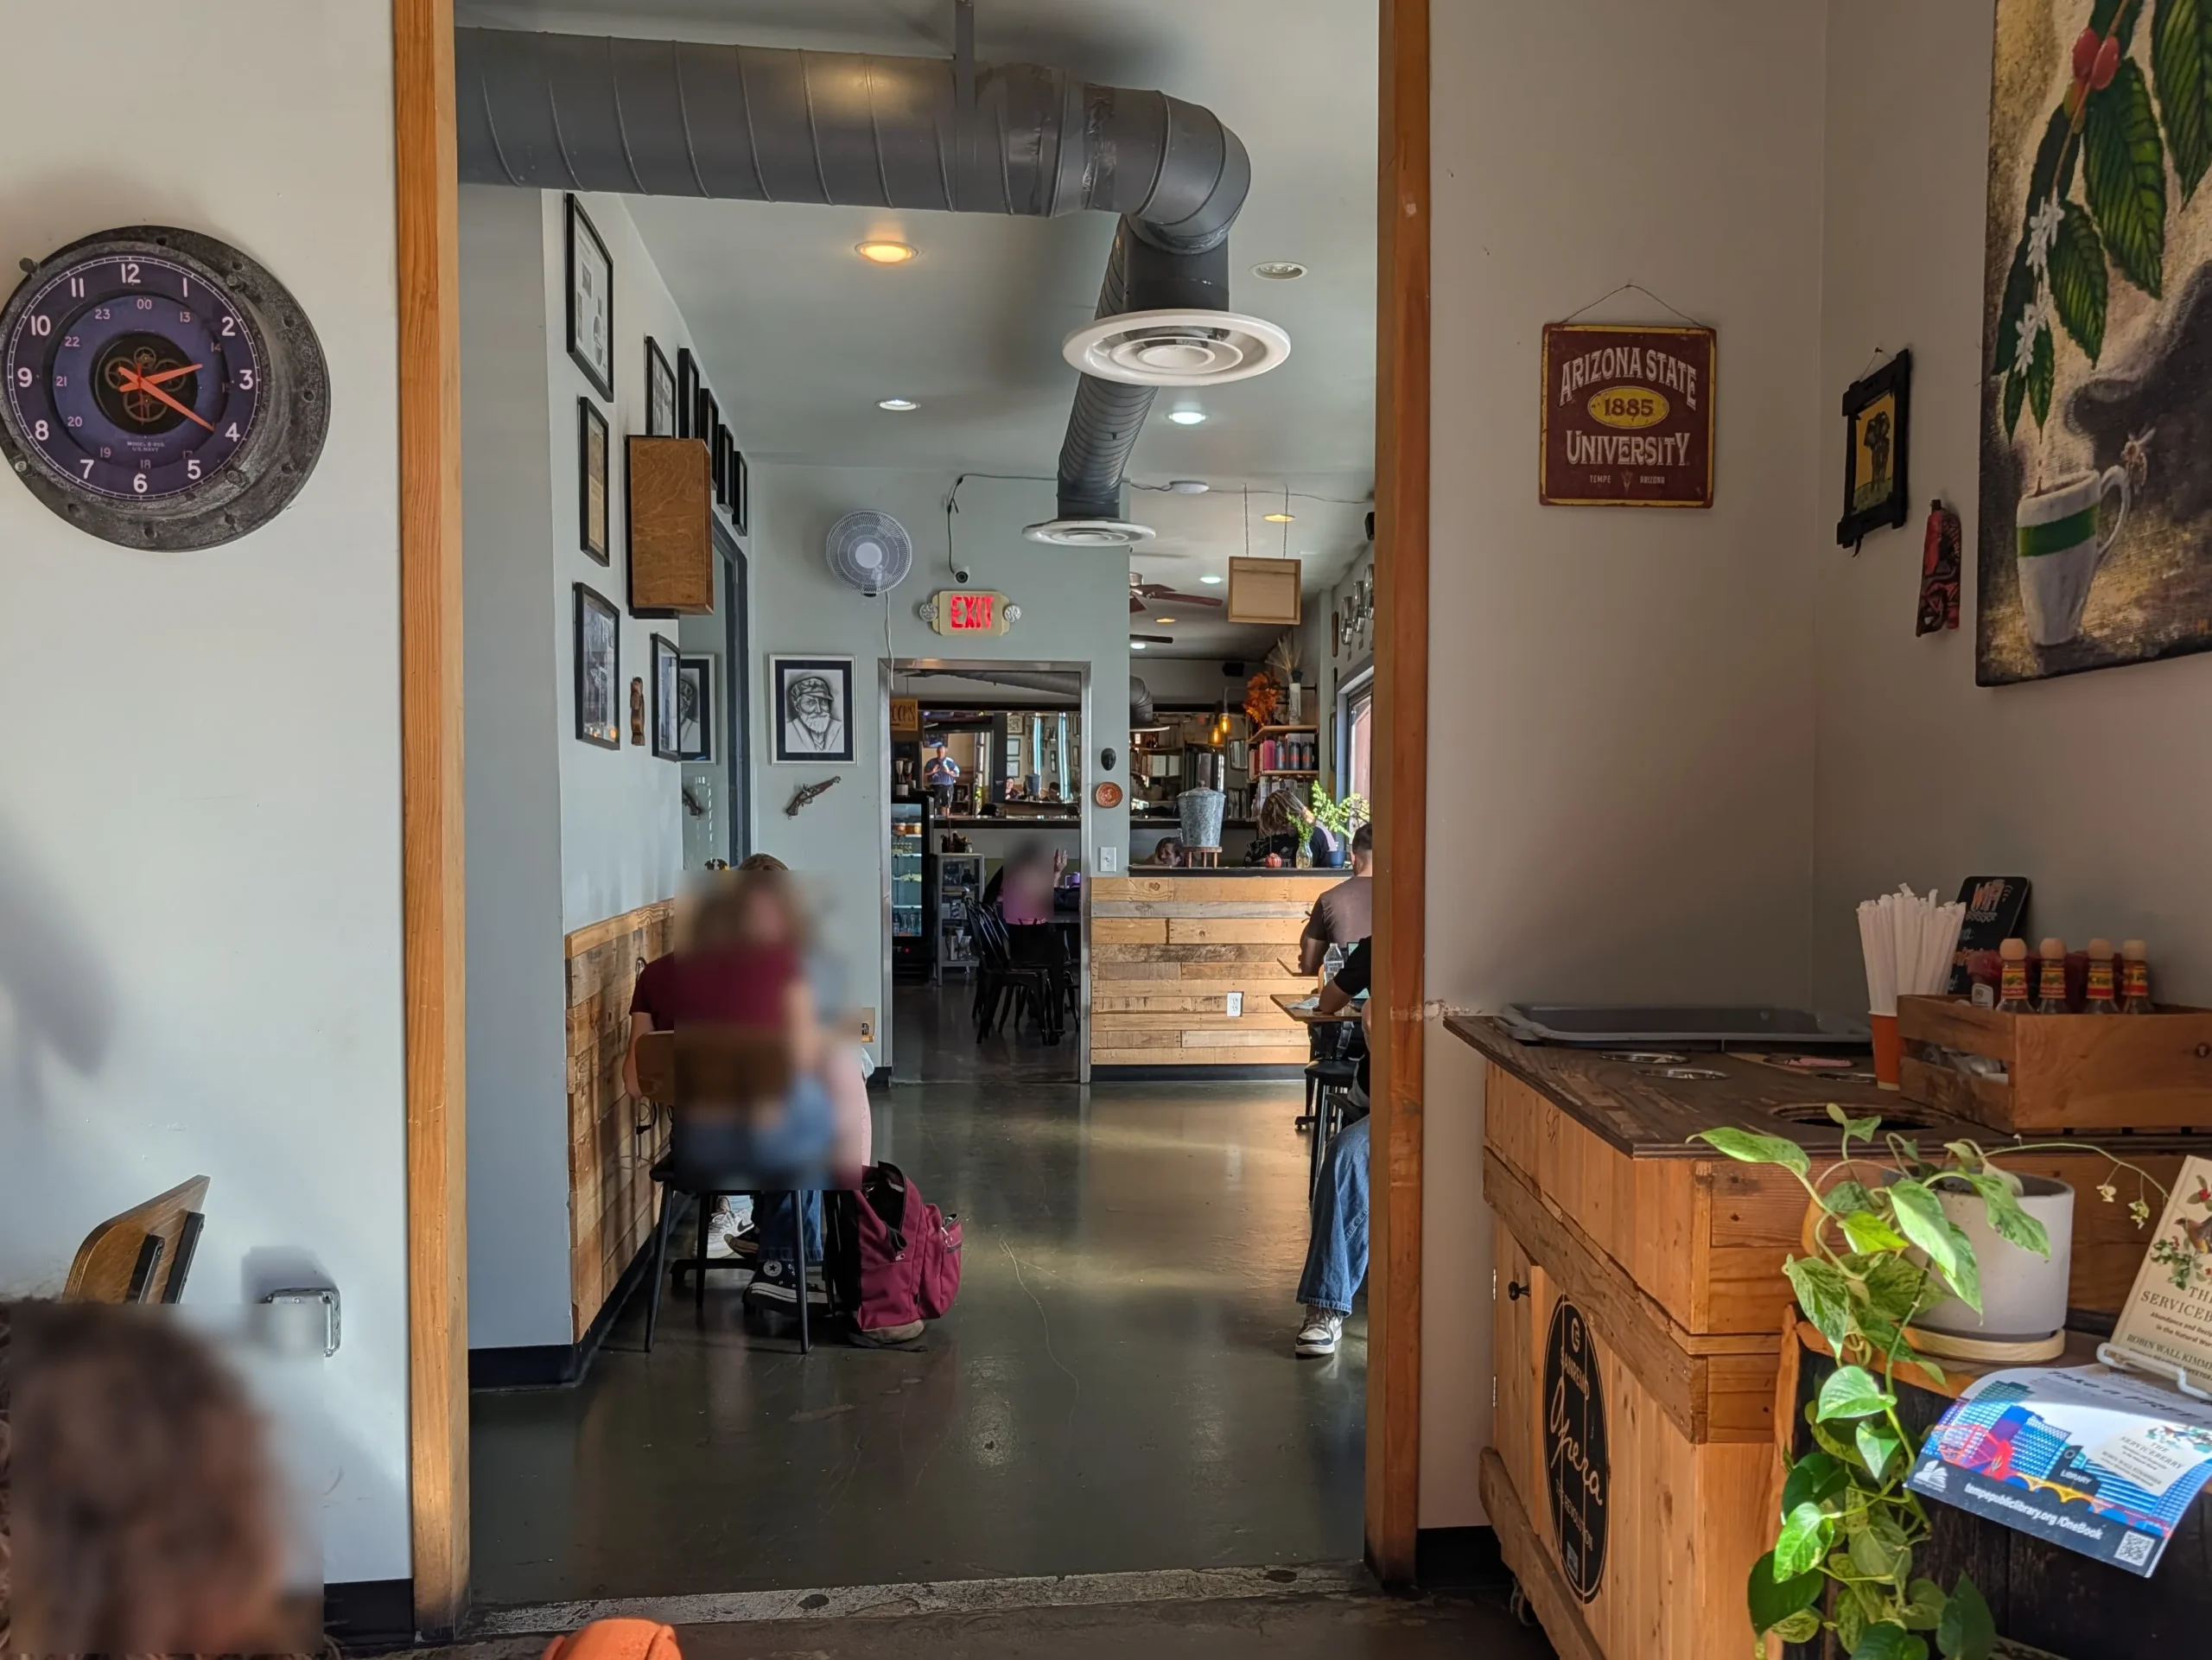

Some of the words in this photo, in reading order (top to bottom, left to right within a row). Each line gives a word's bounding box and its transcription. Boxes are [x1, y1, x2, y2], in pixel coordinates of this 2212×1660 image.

[121, 264, 141, 283] 12
[71, 277, 86, 297] 11
[182, 277, 189, 297] 1
[137, 298, 152, 310] 00
[95, 308, 111, 321] 23
[179, 311, 191, 323] 13
[30, 315, 51, 336] 10
[221, 315, 236, 337] 2
[64, 336, 79, 348] 22
[211, 341, 221, 353] 14
[17, 367, 32, 388] 9
[55, 375, 67, 386] 21
[239, 369, 254, 391] 3
[1559, 347, 1643, 407] ARIZONA
[1645, 348, 1698, 412] STATE
[1604, 398, 1654, 417] 1885
[35, 419, 49, 442] 8
[67, 416, 82, 428] 20
[225, 422, 241, 442] 4
[99, 447, 111, 459] 19
[1566, 429, 1691, 466] UNIVERSITY
[80, 459, 95, 480] 7
[140, 459, 151, 469] 18
[187, 459, 201, 480] 5
[133, 472, 148, 493] 6
[1590, 474, 1611, 484] TEMPE
[950, 594, 993, 629] EXIT
[2126, 1333, 2154, 1351] ROBIN
[2156, 1343, 2181, 1360] WALL
[1560, 1345, 1590, 1402] SANREMO
[1550, 1377, 1603, 1506] Opera
[2060, 1470, 2092, 1485] LIBRARY
